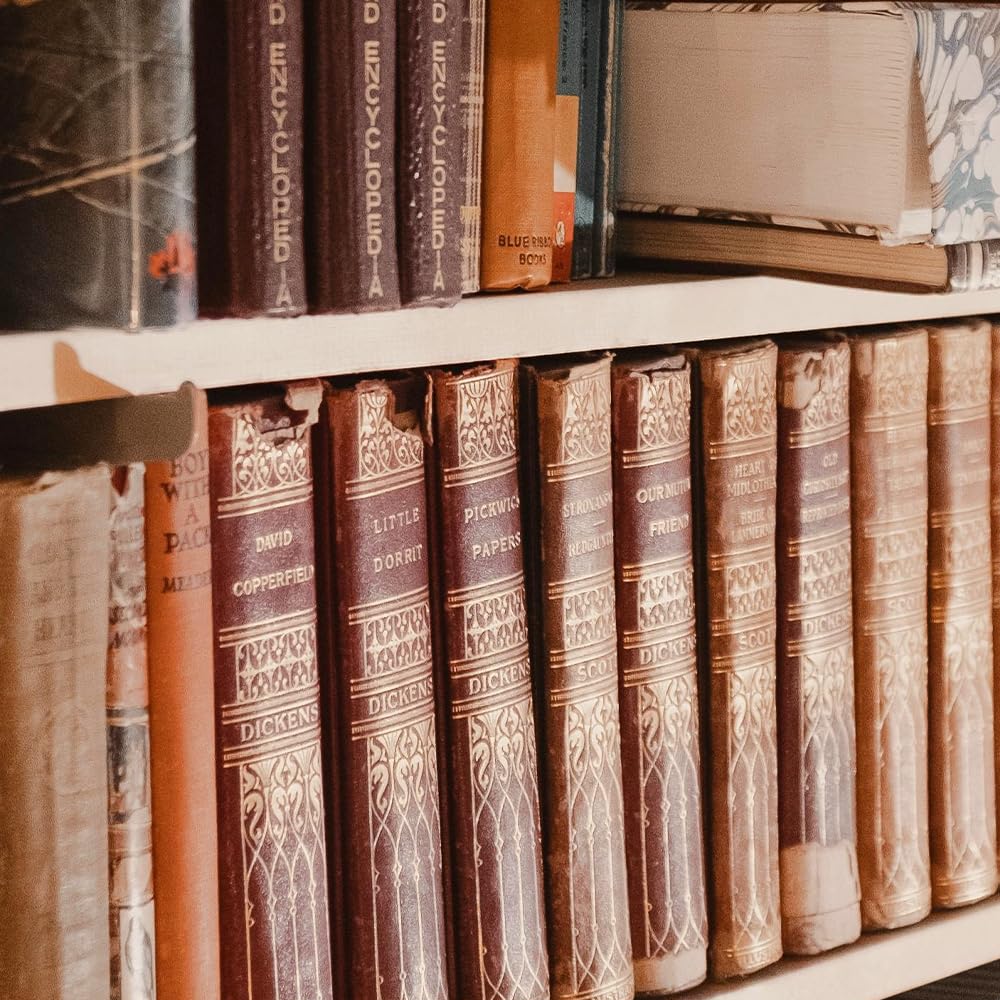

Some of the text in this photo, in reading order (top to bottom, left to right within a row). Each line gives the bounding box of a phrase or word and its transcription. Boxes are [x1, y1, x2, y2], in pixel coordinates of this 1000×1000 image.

[269, 0, 292, 306] D ENCYCLOPEDIA
[363, 0, 384, 299] D ENCYCLOPEDIA
[431, 0, 447, 291] D ENCYCLOPEDIA
[498, 235, 529, 248] BLUE
[519, 253, 546, 265] BOOKS
[734, 460, 766, 479] HEART
[636, 477, 690, 504] OUR MUTU
[184, 503, 200, 524] A
[374, 507, 420, 535] LITTLE
[256, 530, 294, 553] DAVID
[472, 532, 521, 560] PAPERS
[374, 543, 423, 573] DORRIT
[232, 565, 315, 597] COPPERFIELD
[469, 658, 531, 697] DICKENS
[368, 678, 433, 715] DICKENS
[240, 704, 319, 742] DICKENS
